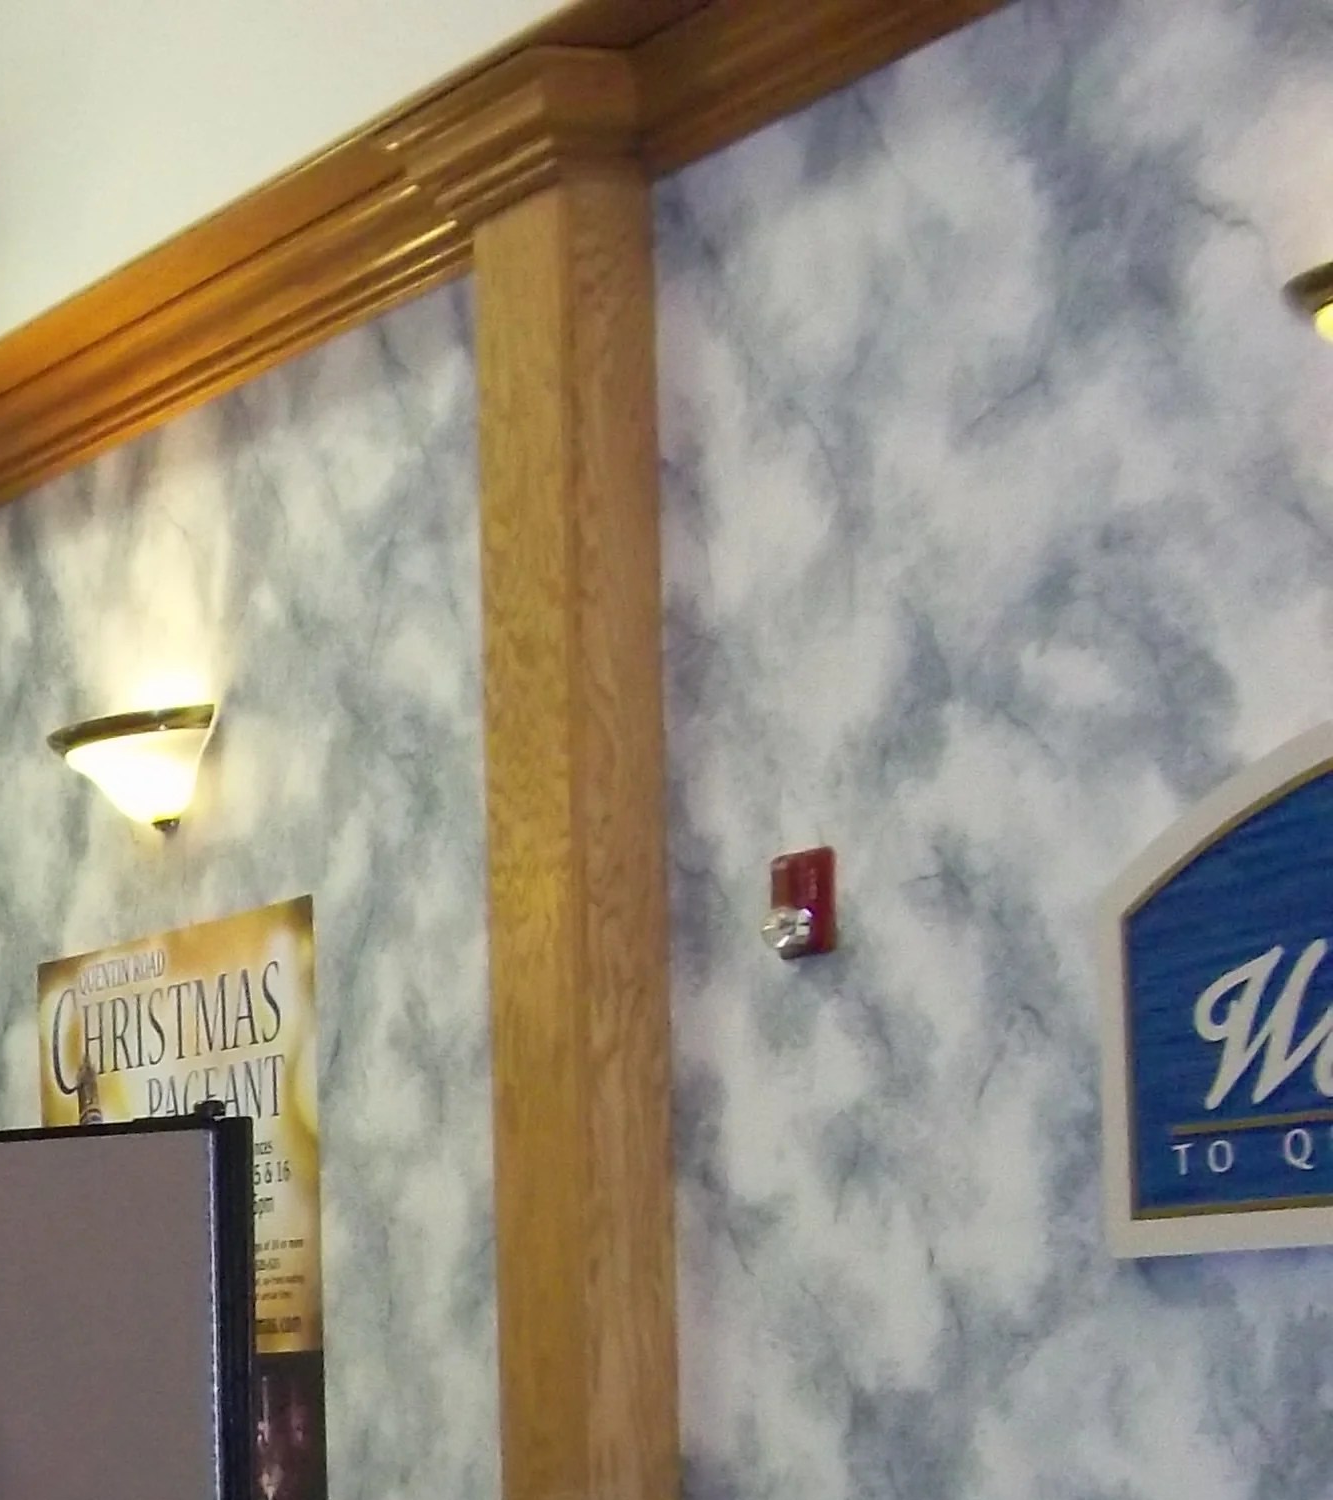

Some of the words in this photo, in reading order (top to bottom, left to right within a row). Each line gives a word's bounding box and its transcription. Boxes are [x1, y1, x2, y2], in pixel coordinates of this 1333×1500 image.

[79, 958, 130, 995] QUENTIN
[132, 949, 166, 983] ROAD
[52, 960, 282, 1095] CHRISTMAS
[1171, 1139, 1234, 1175] TO
[1283, 1127, 1333, 1170] Q
